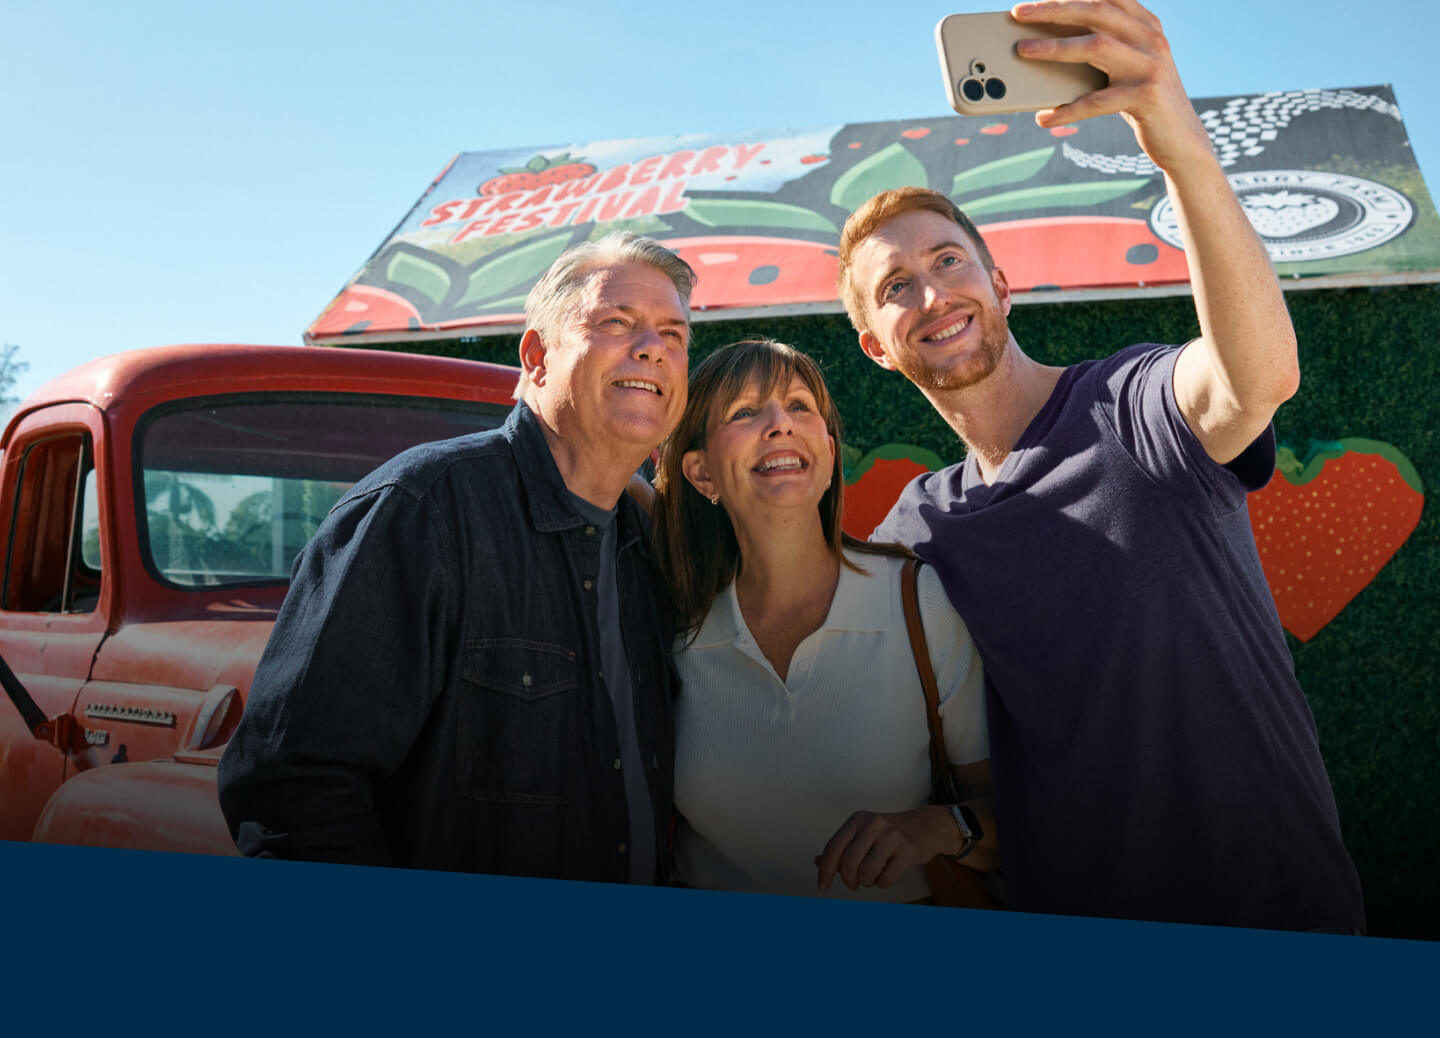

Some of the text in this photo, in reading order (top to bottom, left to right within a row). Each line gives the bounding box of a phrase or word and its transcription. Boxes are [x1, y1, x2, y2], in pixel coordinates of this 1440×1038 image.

[421, 143, 767, 227] STRAWBERRY
[452, 181, 690, 243] FESTIVAL
[1330, 179, 1392, 203] FARM
